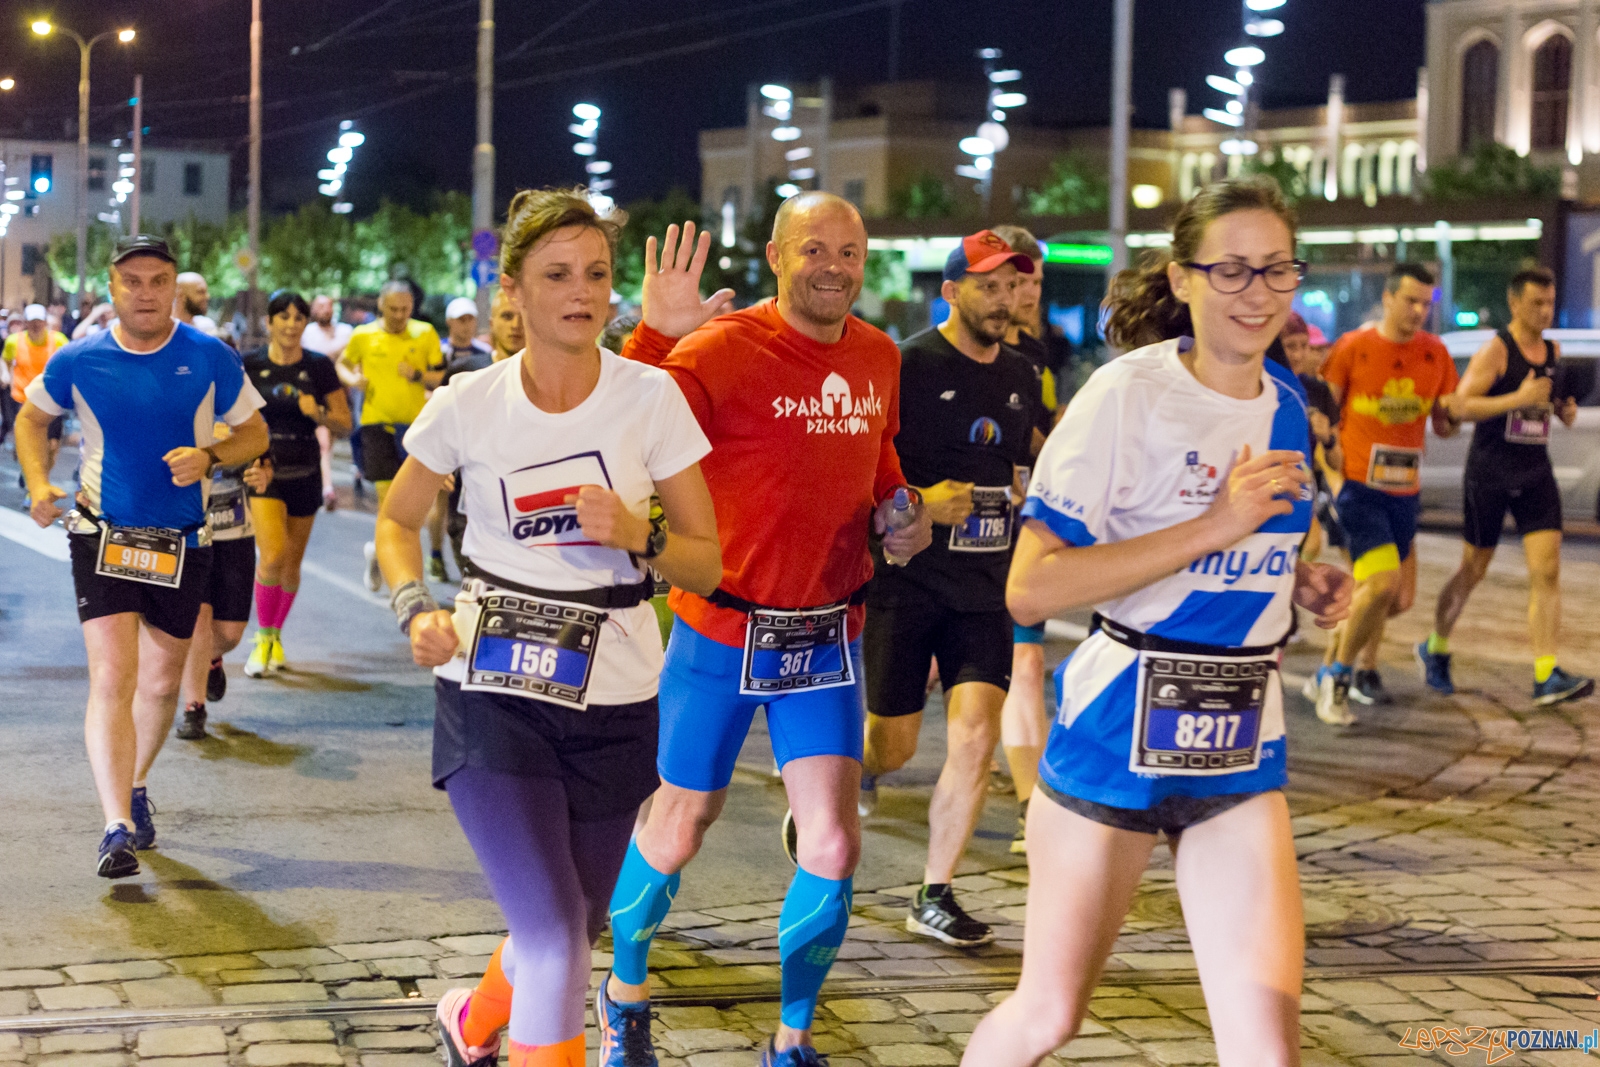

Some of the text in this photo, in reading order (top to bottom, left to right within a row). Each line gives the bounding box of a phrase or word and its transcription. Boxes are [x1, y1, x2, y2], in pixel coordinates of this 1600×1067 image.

[512, 514, 582, 540] GDYN
[979, 517, 1005, 537] 1795
[121, 548, 158, 571] 9191
[510, 642, 558, 678] 156
[779, 649, 814, 676] 367
[1175, 713, 1241, 749] 8217
